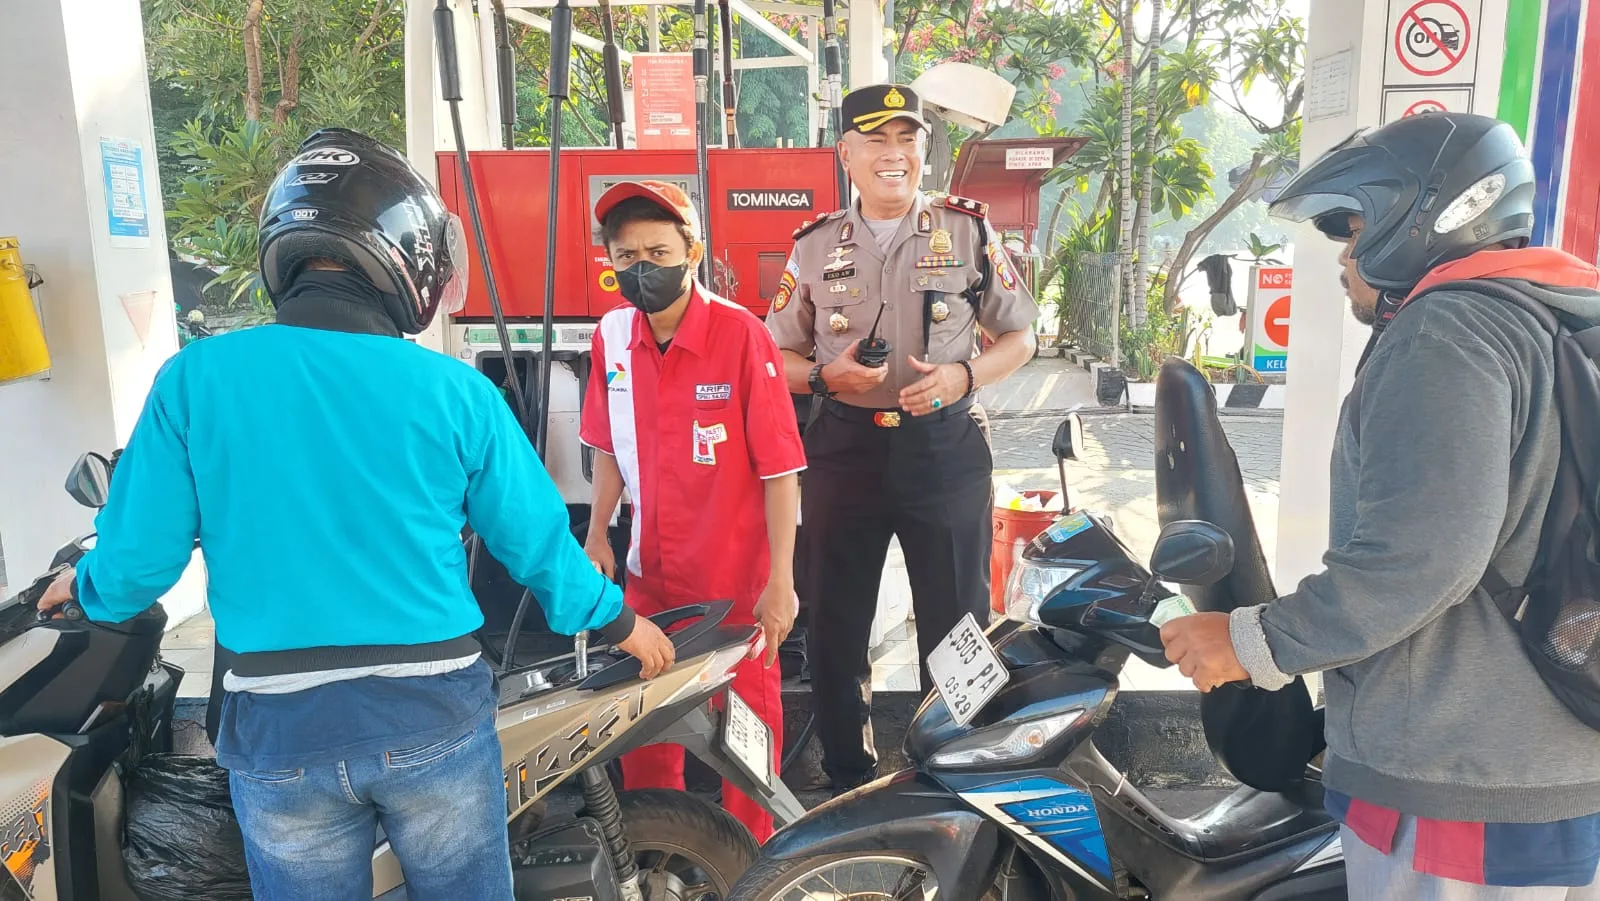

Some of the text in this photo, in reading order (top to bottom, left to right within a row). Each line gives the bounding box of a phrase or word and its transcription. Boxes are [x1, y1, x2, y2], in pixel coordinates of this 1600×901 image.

[732, 193, 810, 207] TOMINAGA
[950, 626, 983, 665] 5505
[975, 661, 999, 694] PA
[1028, 804, 1089, 817] HONDA
